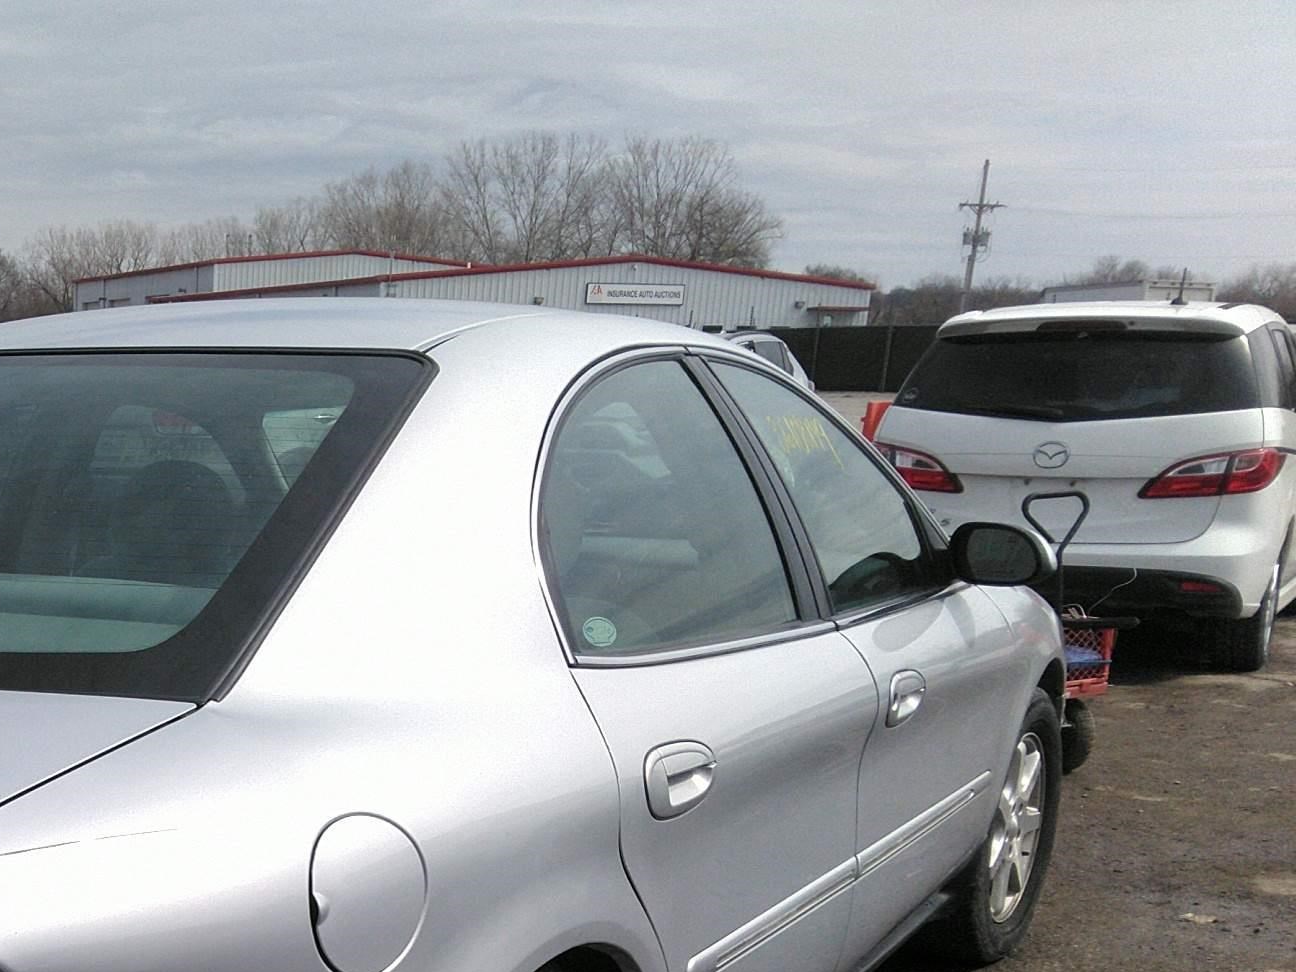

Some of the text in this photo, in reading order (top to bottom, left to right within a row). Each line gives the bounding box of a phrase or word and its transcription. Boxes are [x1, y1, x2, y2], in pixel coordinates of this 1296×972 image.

[607, 289, 638, 298] INSURANCE
[639, 290, 653, 299] AUTO
[654, 290, 681, 299] AUCTIONS
